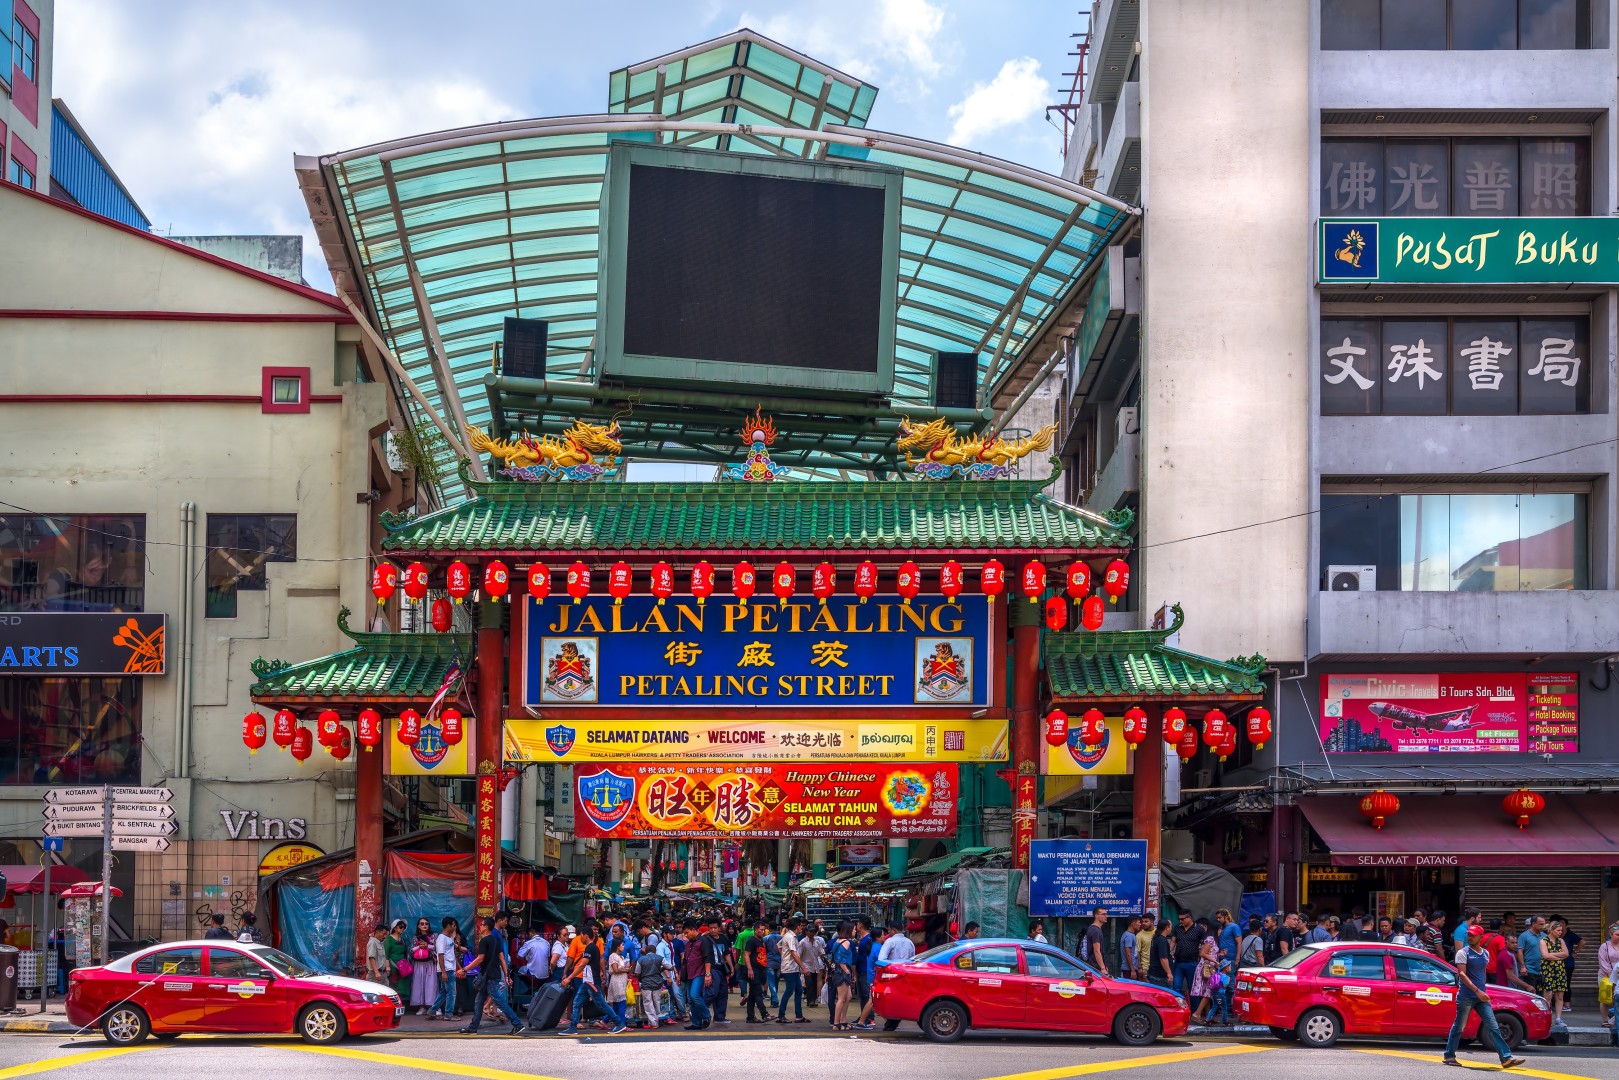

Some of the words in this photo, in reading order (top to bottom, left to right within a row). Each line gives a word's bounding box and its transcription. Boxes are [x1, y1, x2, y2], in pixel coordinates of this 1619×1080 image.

[1324, 161, 1579, 211] 佛光普照
[1324, 336, 1581, 390] 文殊書局
[549, 604, 707, 633] JALAN
[721, 604, 966, 633] PETALING
[618, 675, 768, 696] PETALING
[778, 675, 894, 696] STREET
[1367, 677, 1406, 697] Civic
[1409, 685, 1438, 697] Travels
[1441, 686, 1447, 697] &
[1449, 686, 1473, 697] Tours
[1476, 686, 1494, 697] Sdn.
[1496, 686, 1515, 697] Bhd.
[1535, 695, 1562, 705] Ticketing
[1535, 710, 1550, 720] Hotel
[1551, 710, 1575, 720] Booking
[1535, 724, 1559, 734] Package
[1561, 724, 1577, 734] Tours
[587, 731, 641, 743] SELAMAT
[642, 731, 689, 743] DATANG
[708, 731, 765, 743] WELCOME
[780, 732, 842, 748] 欢迎光临
[926, 725, 937, 757] 丙申年
[1535, 741, 1549, 751] City
[1551, 741, 1564, 750] Tours
[785, 771, 826, 784] Happy
[828, 771, 876, 782] Chinese
[802, 786, 831, 798] New
[833, 786, 860, 798] Year
[783, 803, 837, 813] SELAMAT
[839, 803, 878, 813] TAHUN
[1521, 796, 1535, 809] 福
[220, 809, 306, 840] Vins
[800, 816, 830, 826] BARU
[833, 816, 861, 826] CINA
[1358, 856, 1409, 865] SELAMAT
[1416, 856, 1458, 865] DATANG
